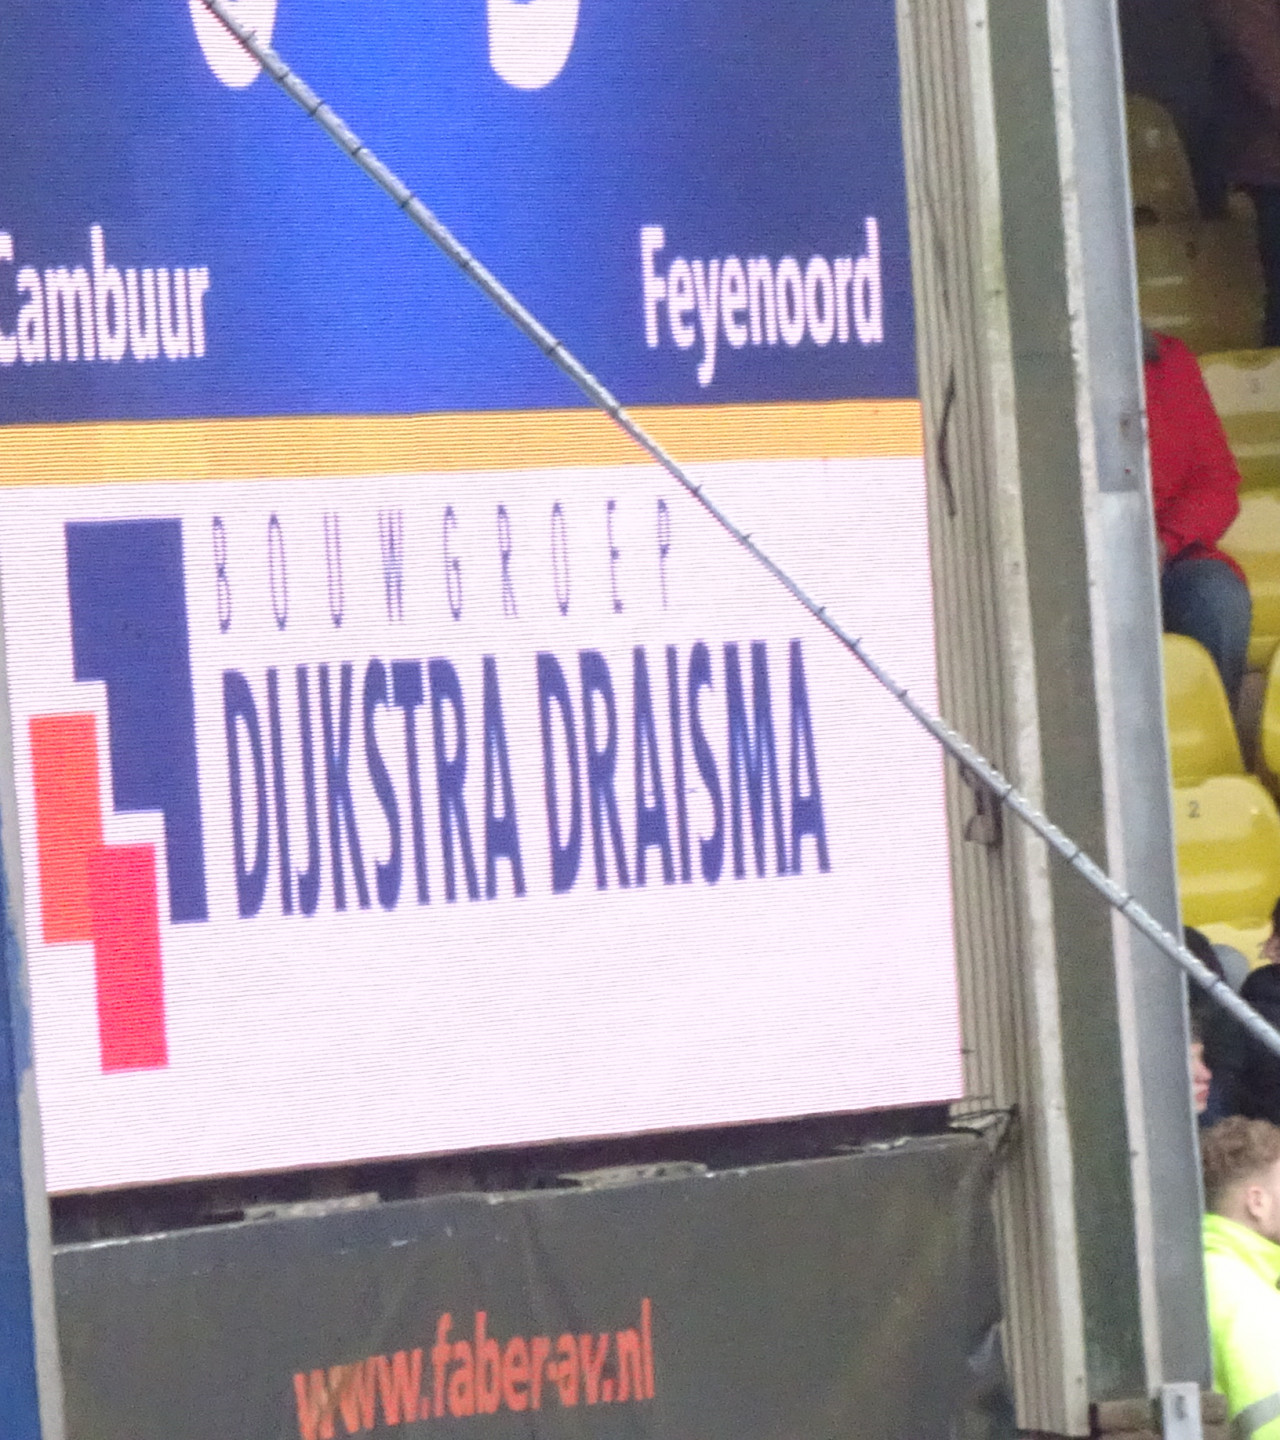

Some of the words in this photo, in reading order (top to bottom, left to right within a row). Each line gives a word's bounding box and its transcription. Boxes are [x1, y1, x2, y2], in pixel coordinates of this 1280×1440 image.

[640, 217, 884, 385] Feyenoord
[211, 497, 672, 635] BOUWGROEP
[222, 654, 527, 921] DIJKSTRA
[535, 637, 832, 896] DRAISMA
[1187, 799, 1201, 818] 2
